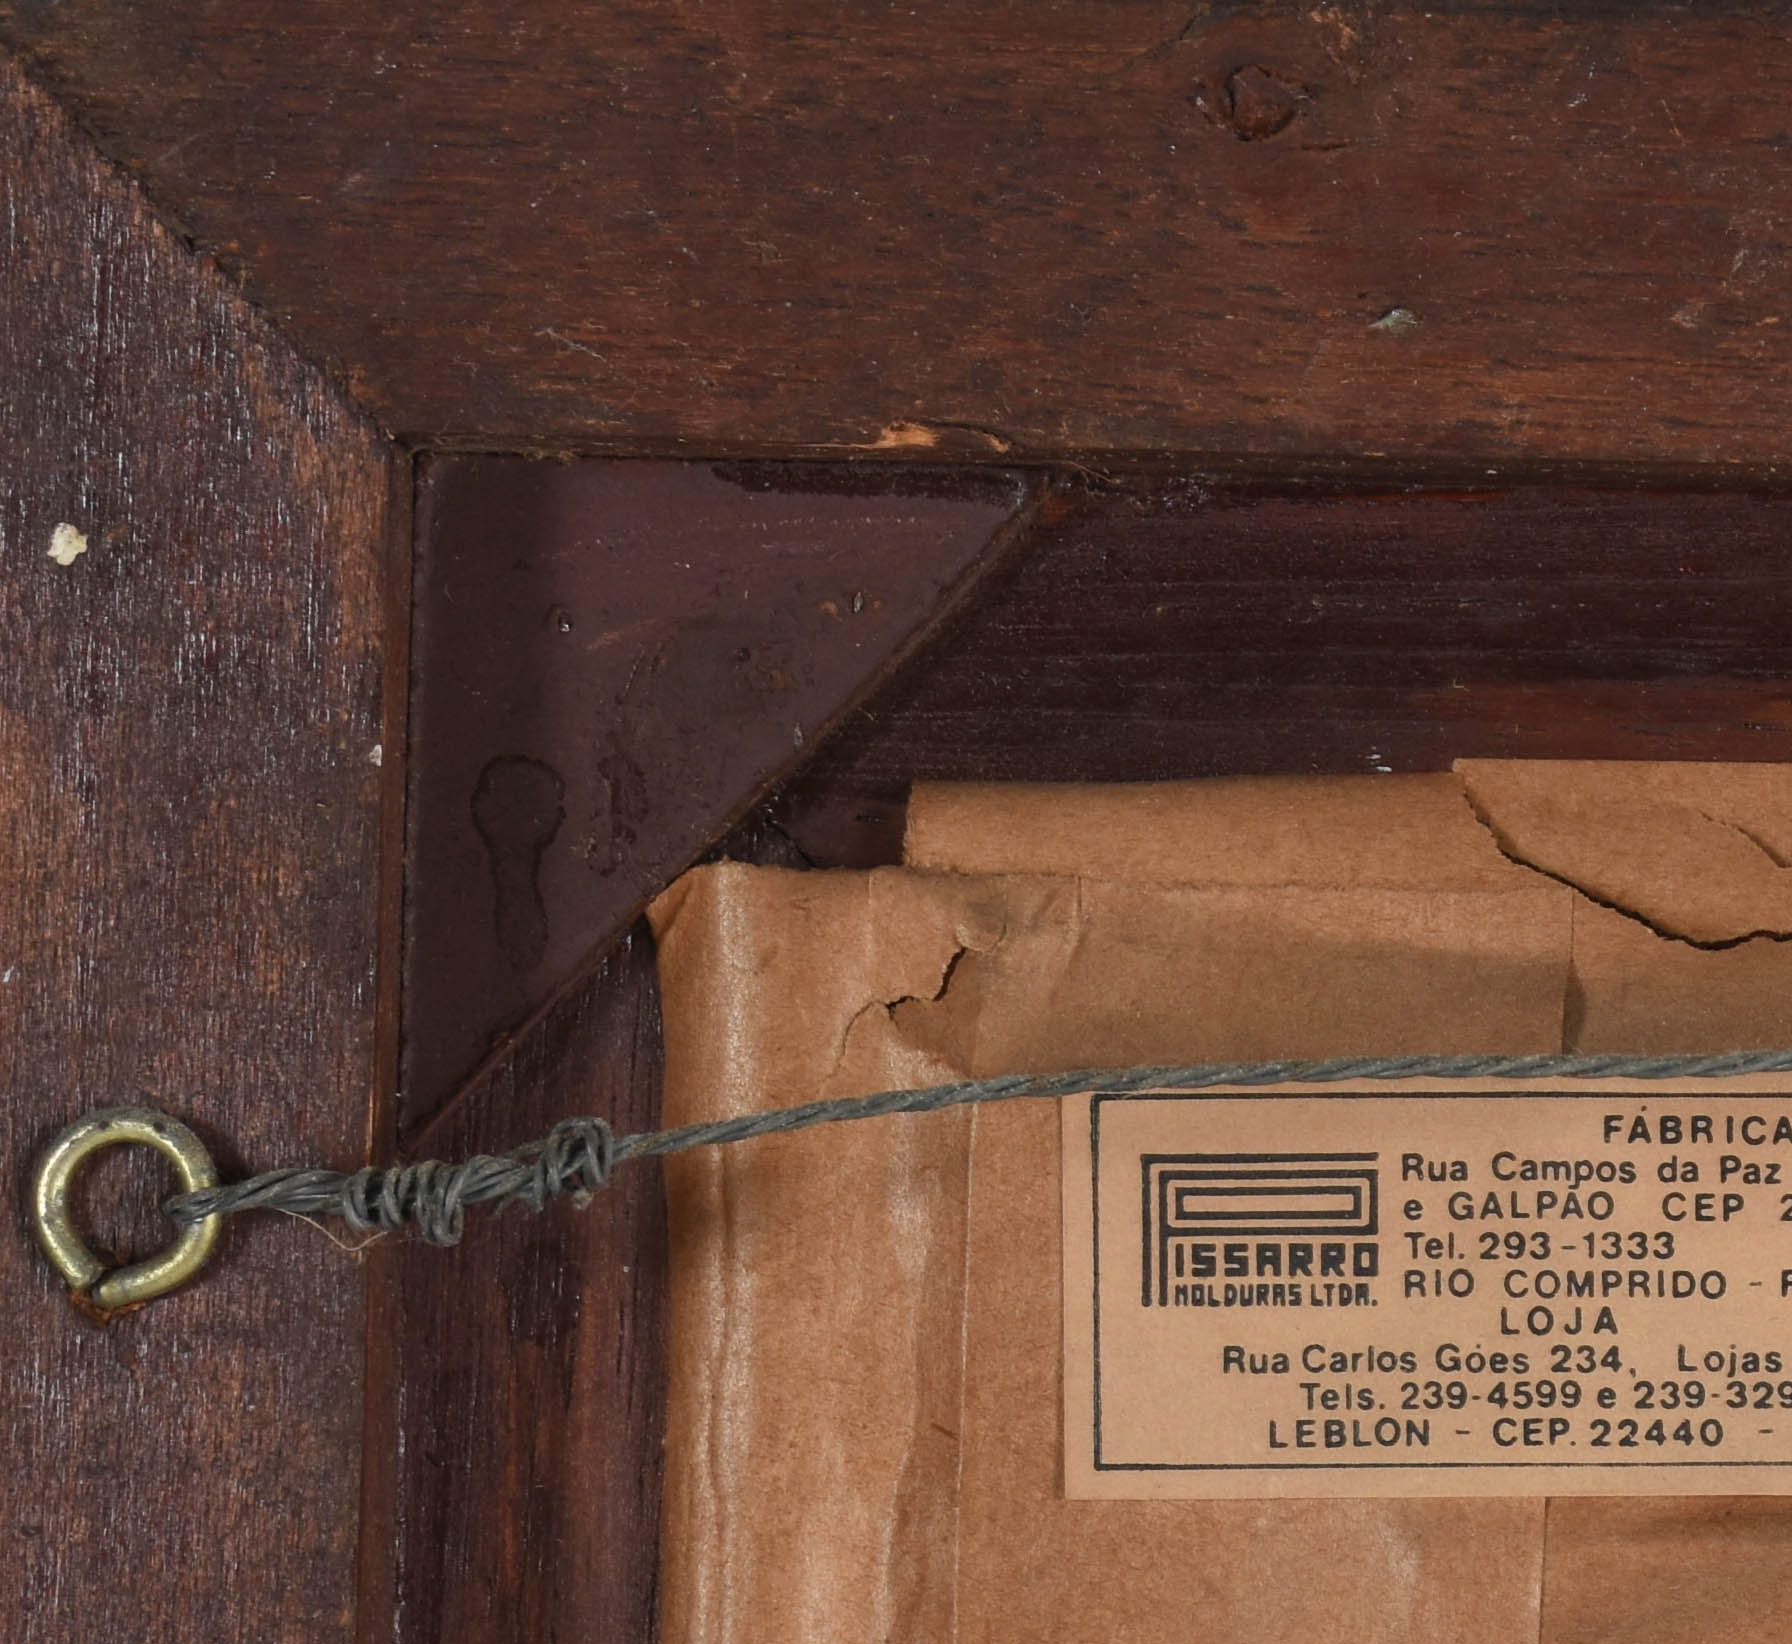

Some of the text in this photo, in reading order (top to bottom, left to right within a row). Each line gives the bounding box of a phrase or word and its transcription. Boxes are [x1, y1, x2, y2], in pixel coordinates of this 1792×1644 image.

[1402, 1152, 1469, 1182] Rua
[1491, 1151, 1637, 1190] Campos
[1658, 1156, 1699, 1184] da
[1403, 1199, 1424, 1221] e
[1661, 1192, 1745, 1222] CEP
[1403, 1231, 1675, 1261] Tel. 293-1333
[1174, 1282, 1378, 1308] MOLDURAS LTDA.
[1403, 1269, 1475, 1298] RIO
[1503, 1269, 1727, 1299] COMPRIDO
[1500, 1306, 1618, 1336] LOJA
[1222, 1346, 1290, 1375] Rua
[1302, 1343, 1418, 1374] Carlos
[1550, 1344, 1637, 1378] 234,
[1677, 1344, 1783, 1378] Lojas
[1299, 1382, 1386, 1411] Tels.
[1400, 1380, 1582, 1410] 239-4599
[1596, 1386, 1617, 1409] e
[1269, 1417, 1430, 1449] LEBLON
[1492, 1417, 1577, 1447] CEP.
[1589, 1418, 1724, 1448] 22440
